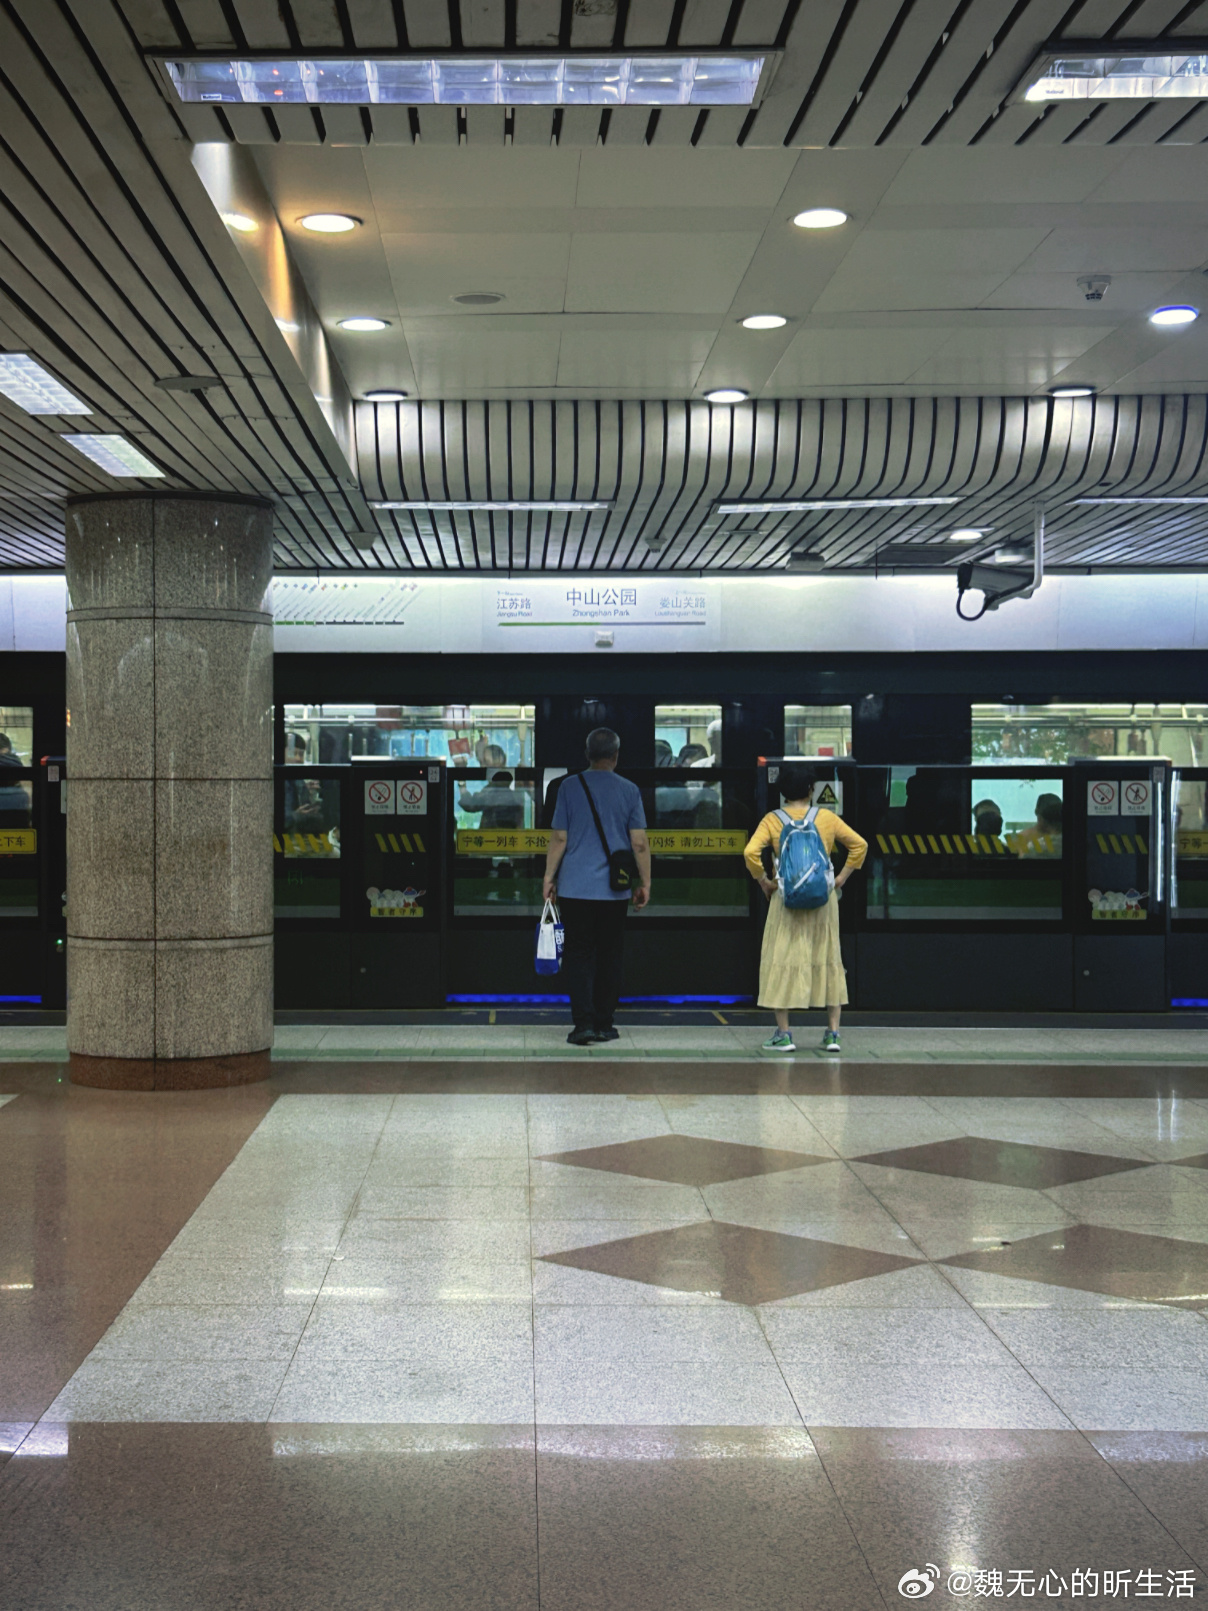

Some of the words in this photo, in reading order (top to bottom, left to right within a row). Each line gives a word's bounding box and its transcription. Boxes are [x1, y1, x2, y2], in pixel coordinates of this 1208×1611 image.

[496, 597, 531, 610] 江苏路
[566, 588, 637, 606] 中山公园
[659, 596, 706, 609] 娄山关路
[572, 609, 612, 618] Zhongshan
[613, 609, 630, 617] Park
[462, 835, 519, 848] 宁等一列车
[525, 835, 550, 848] 不抢
[680, 836, 738, 848] 请勿上下车
